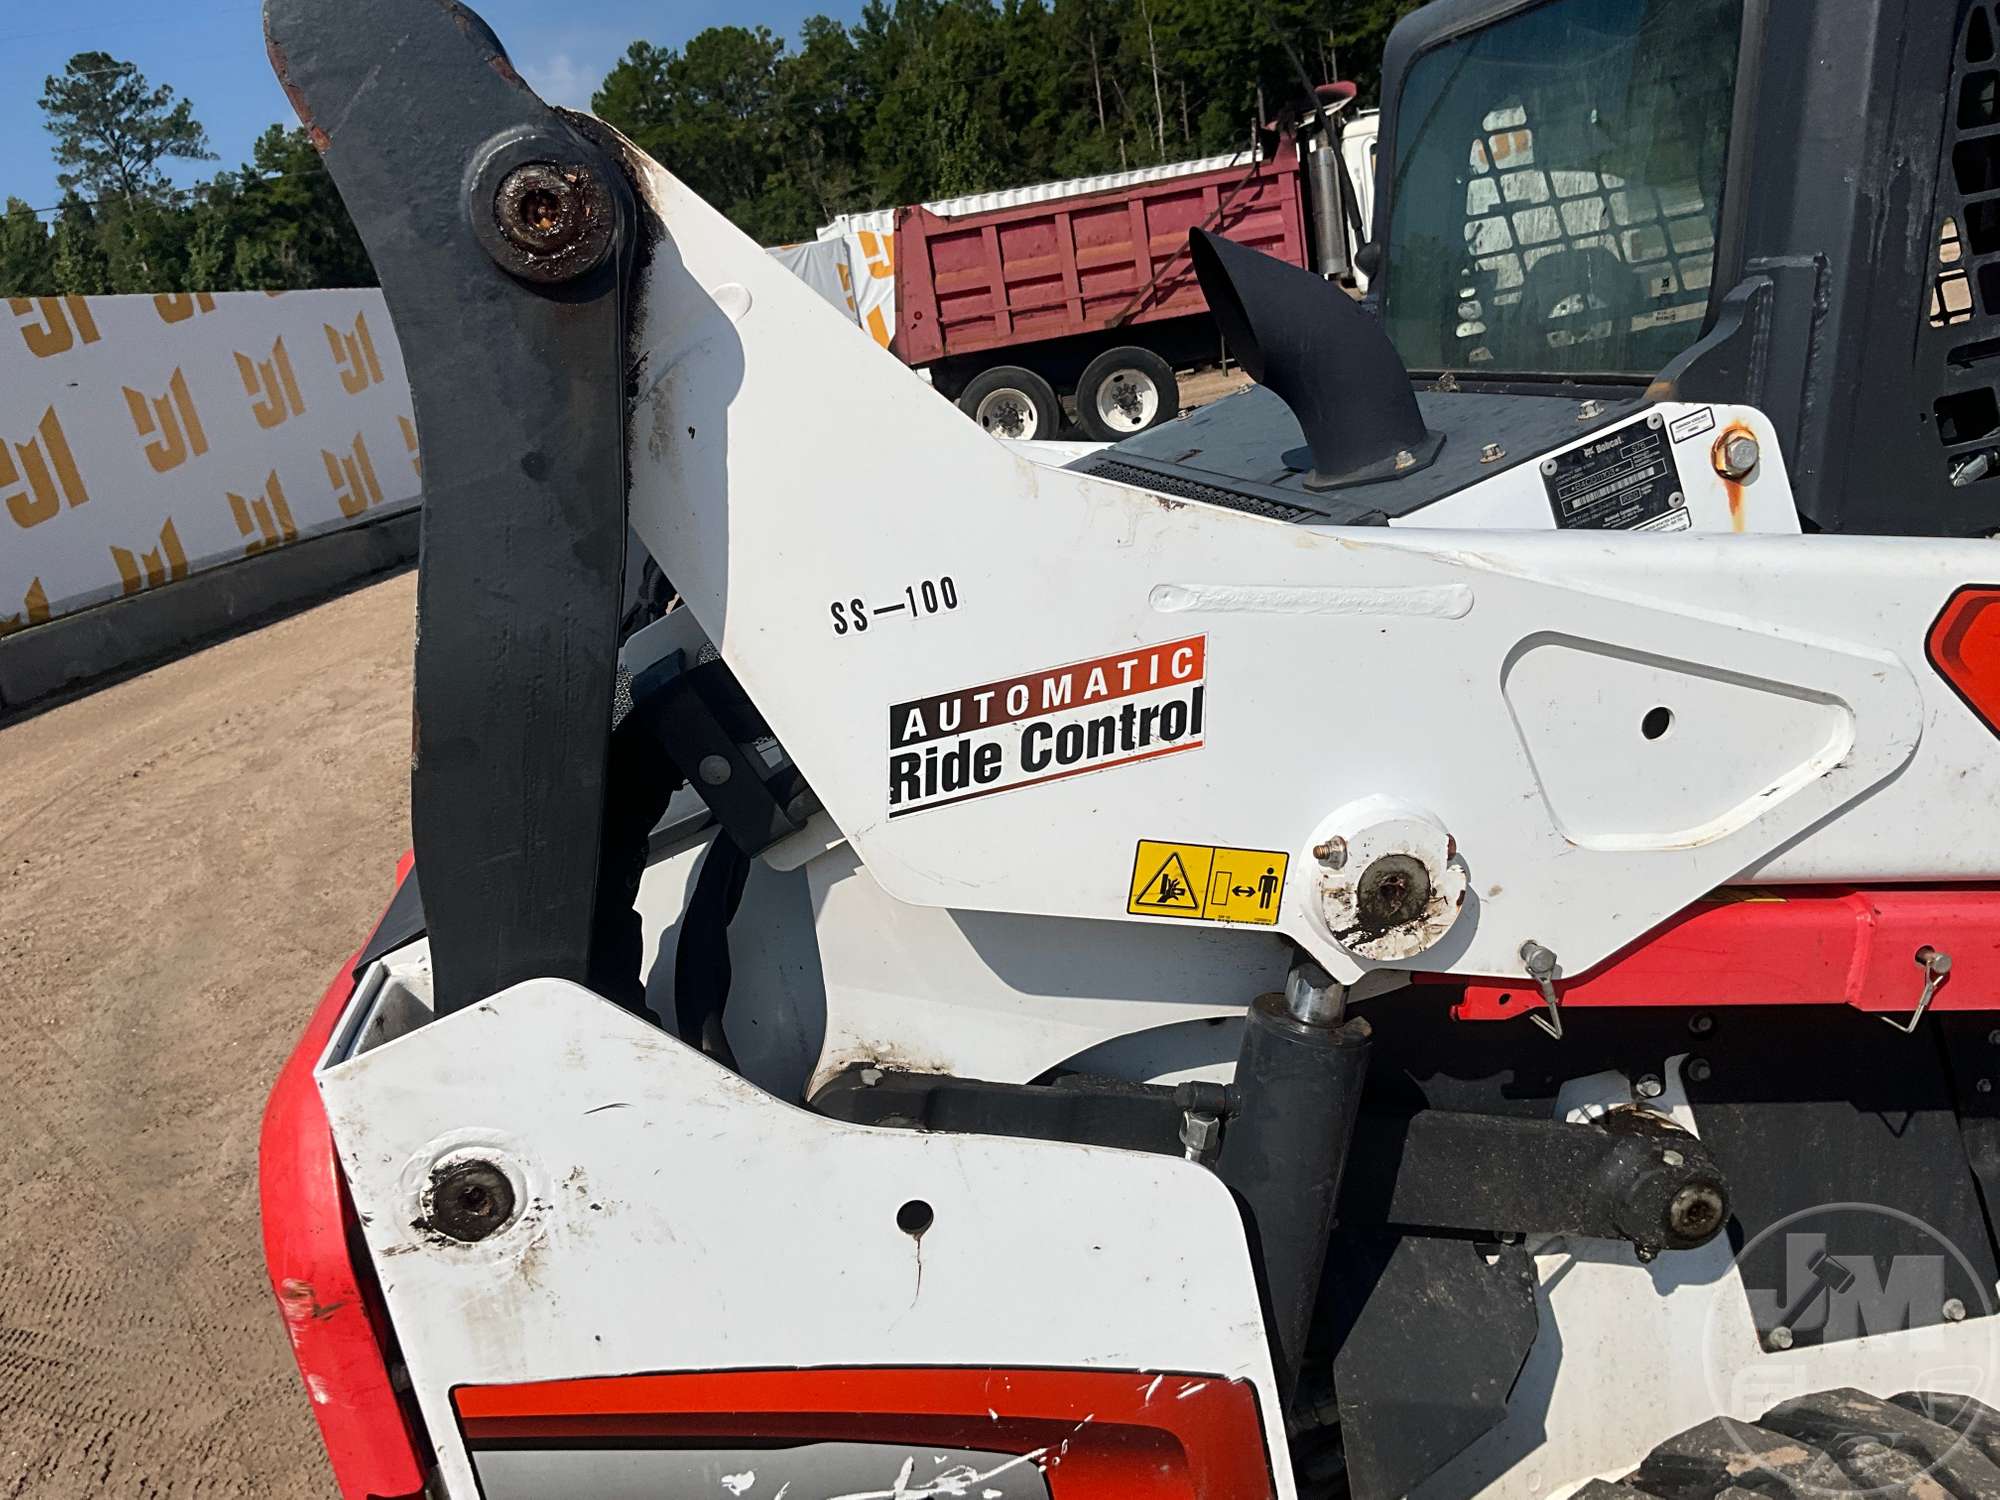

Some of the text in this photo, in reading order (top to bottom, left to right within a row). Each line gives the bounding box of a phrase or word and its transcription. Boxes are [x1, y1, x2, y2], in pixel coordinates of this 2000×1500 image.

[1595, 436, 1622, 454] Bobcat
[902, 646, 1194, 743] AUTOMATIC
[889, 686, 1204, 804] Ride Control
